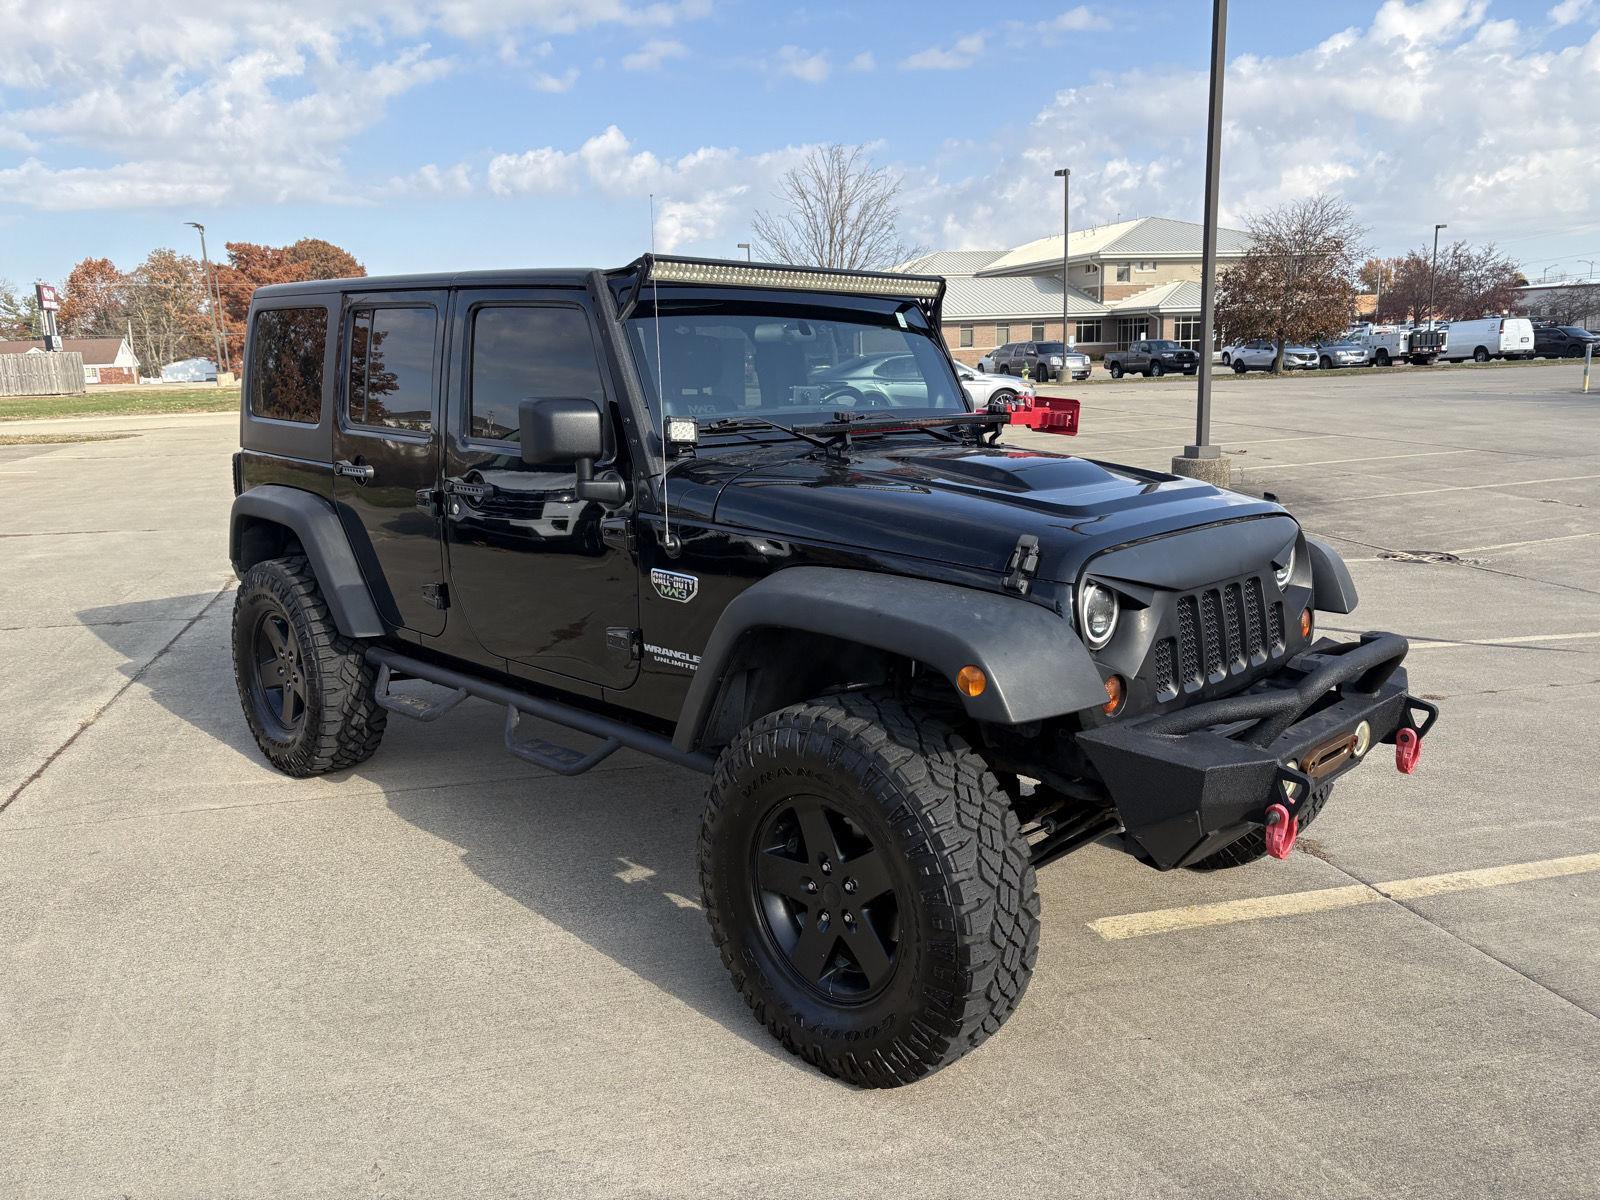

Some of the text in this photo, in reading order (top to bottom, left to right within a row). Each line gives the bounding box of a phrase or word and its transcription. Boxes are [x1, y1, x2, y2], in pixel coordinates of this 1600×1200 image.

[653, 572, 694, 591] CALL DUTY
[661, 585, 687, 599] MW3
[643, 643, 702, 664] WRANGLE
[653, 655, 698, 671] UNLIMITE
